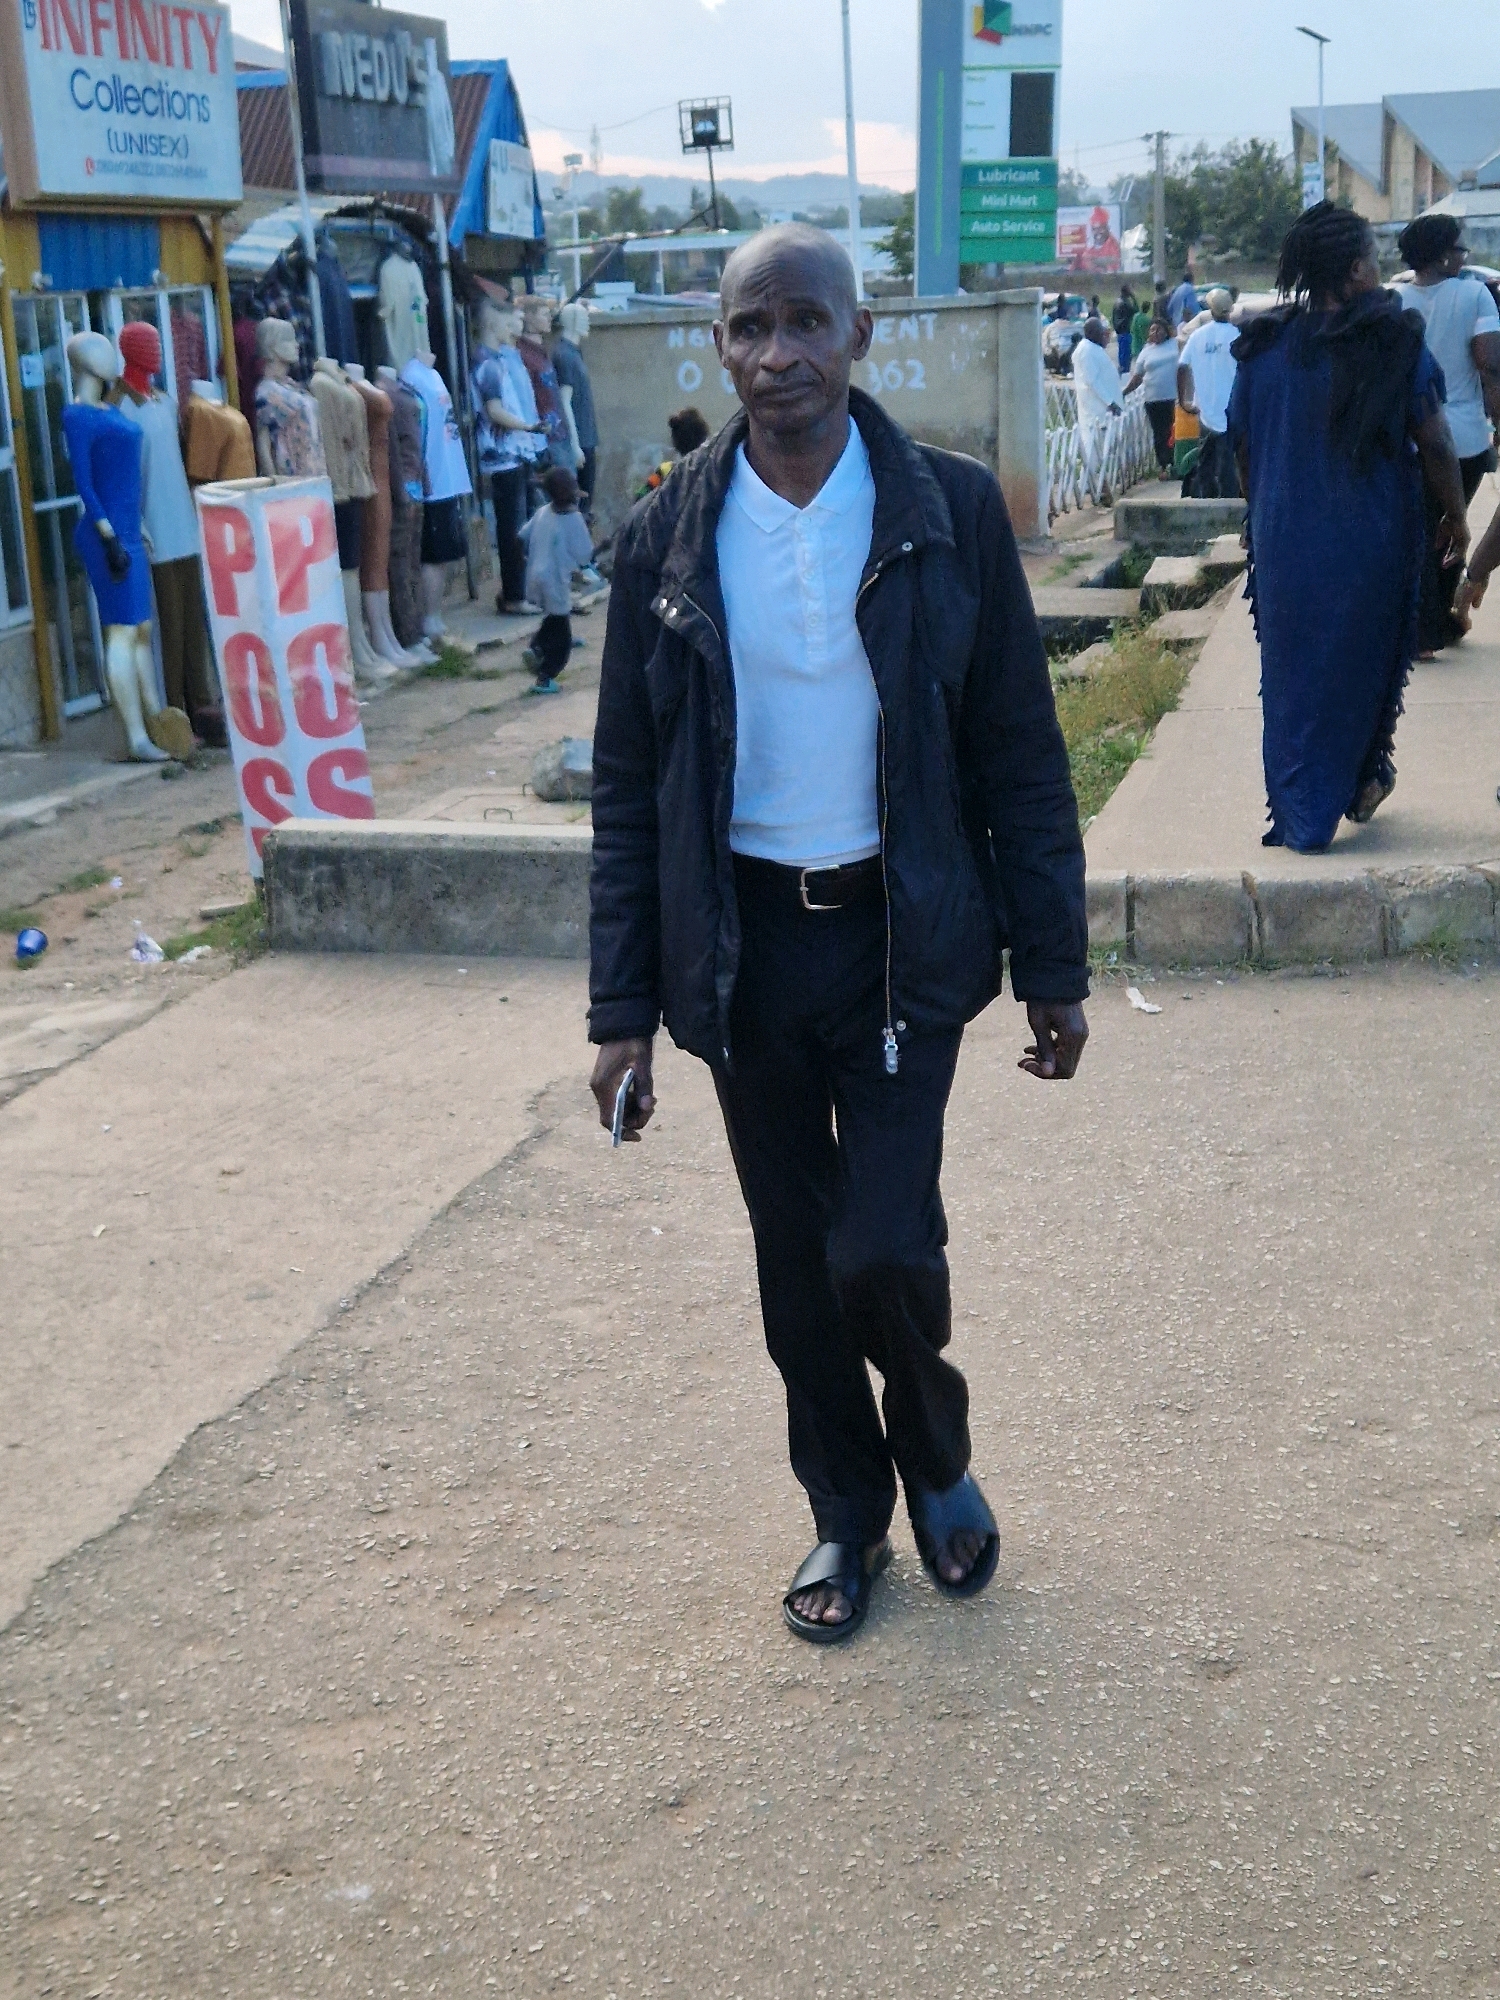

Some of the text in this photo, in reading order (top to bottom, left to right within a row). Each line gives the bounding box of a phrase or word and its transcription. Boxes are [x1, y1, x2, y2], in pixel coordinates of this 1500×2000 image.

[39, 0, 222, 75] INFINITY
[70, 67, 211, 123] Collections
[107, 127, 189, 159] (UNISEX)
[978, 167, 1041, 182] Lubricant
[982, 194, 1038, 207] Mini Mart
[971, 220, 1046, 233] Auto Service
[872, 312, 938, 344] ENT
